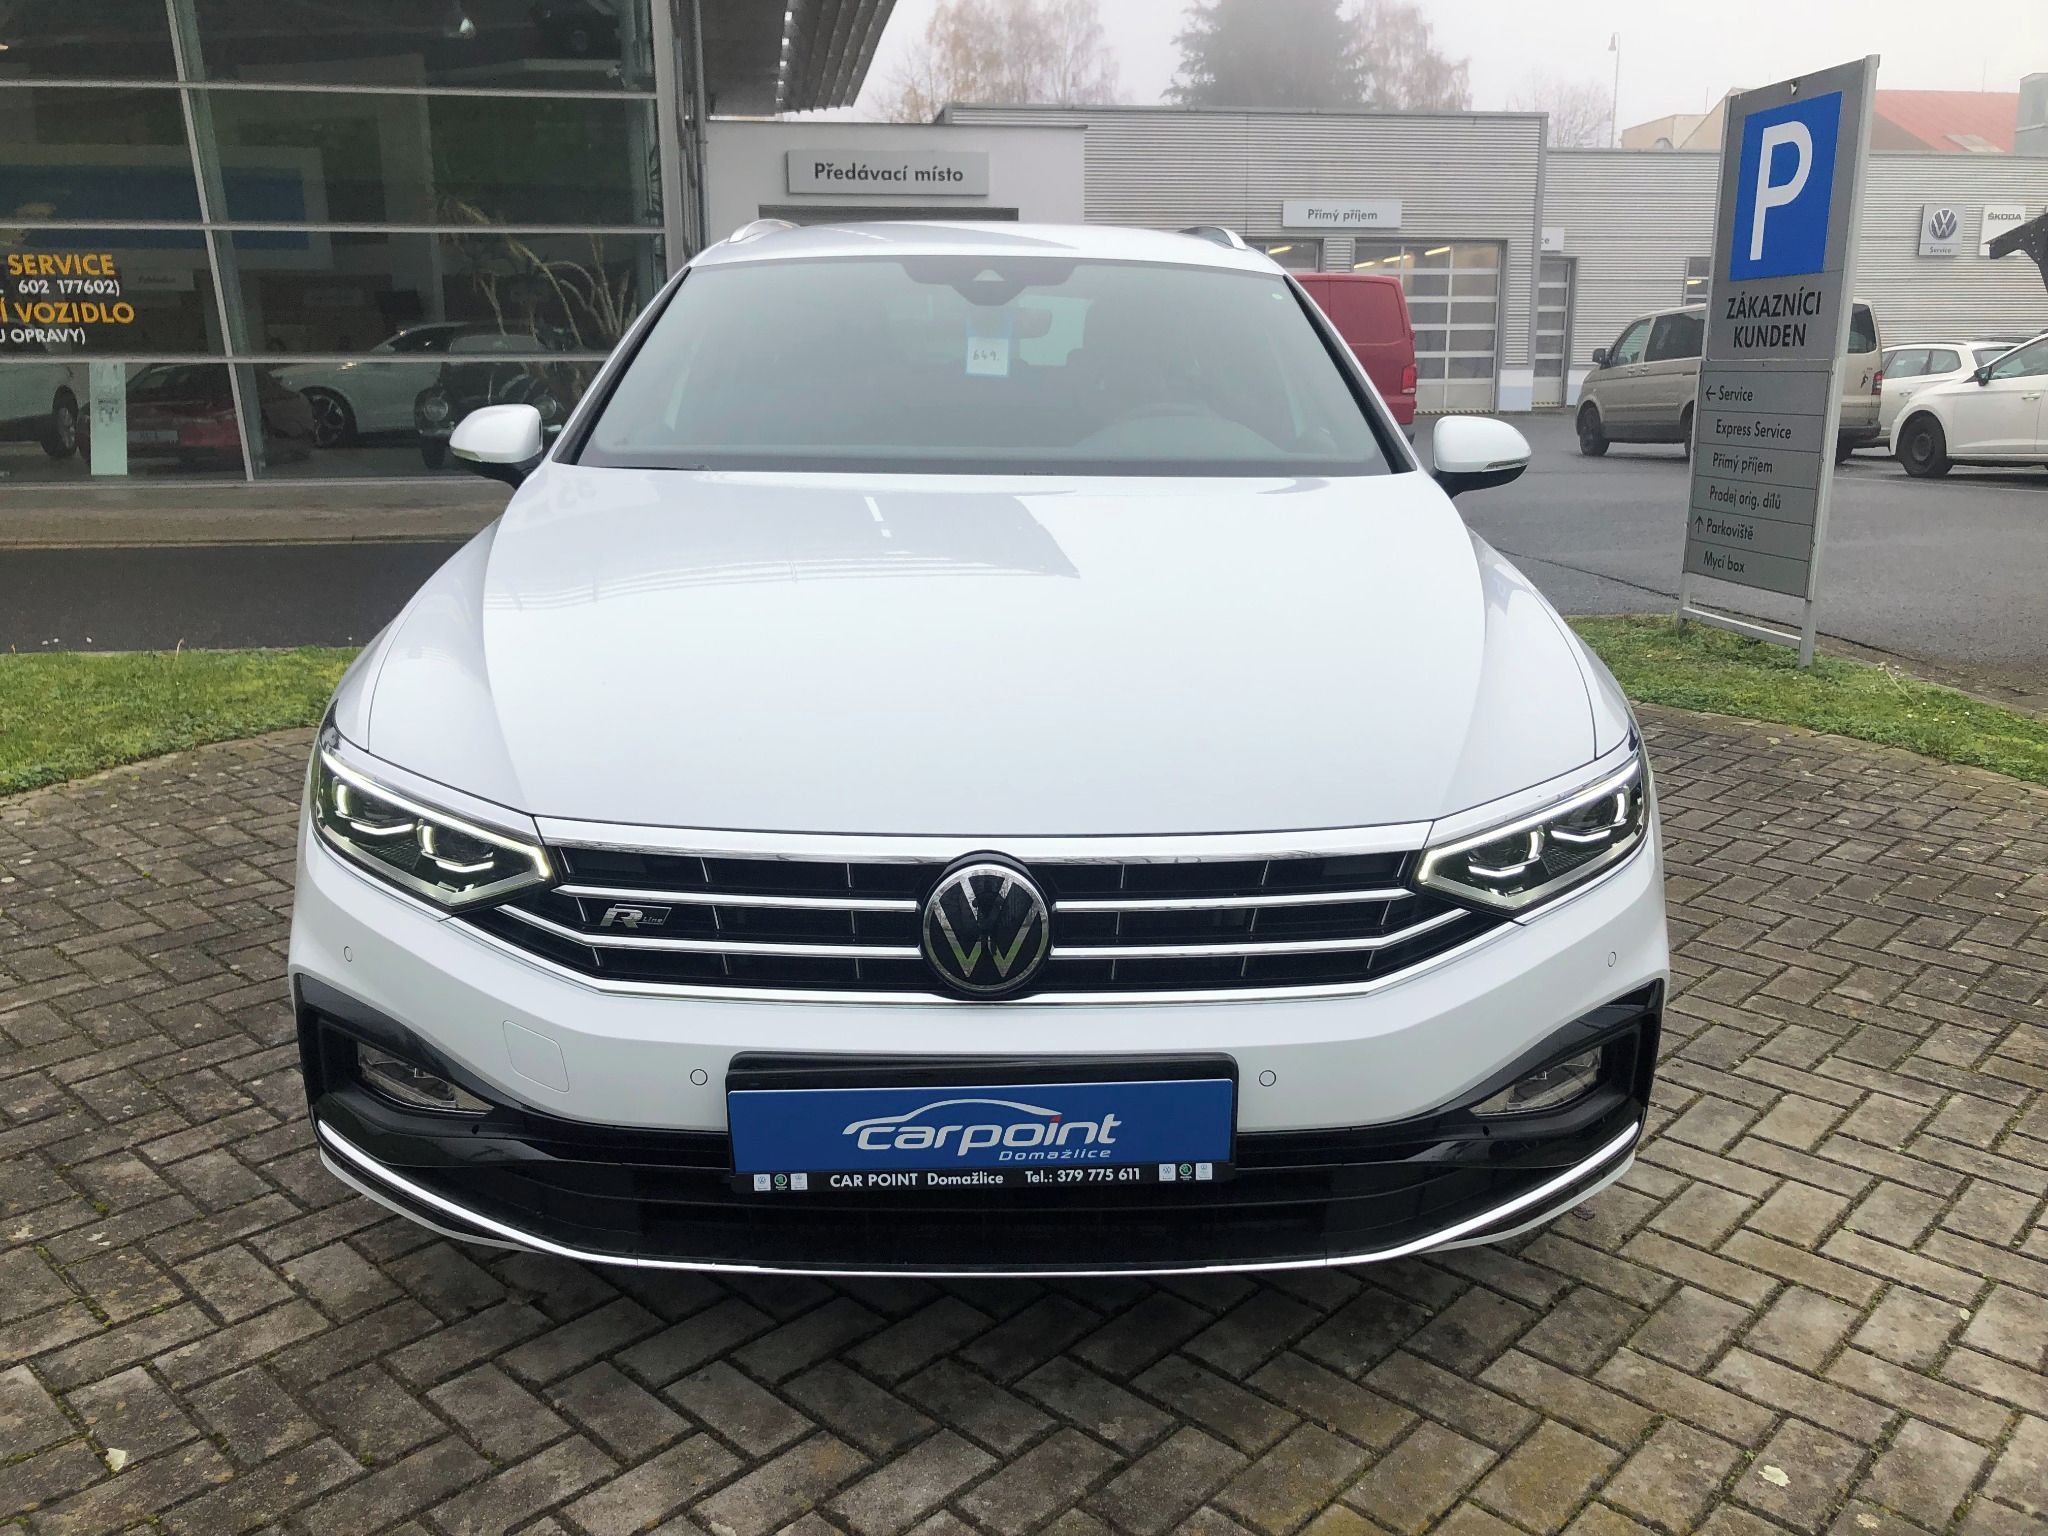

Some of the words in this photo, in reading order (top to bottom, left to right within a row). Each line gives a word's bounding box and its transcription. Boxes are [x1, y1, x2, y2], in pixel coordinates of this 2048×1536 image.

[814, 162, 908, 182] Předávací
[914, 165, 964, 183] místo
[1750, 121, 1812, 261] P
[1307, 208, 1339, 222] Přímý
[1343, 209, 1378, 222] příjem
[8, 254, 116, 275] SERVICE
[18, 280, 50, 294] 602
[57, 279, 120, 297] 177602)
[14, 302, 135, 324] VOZIDLO
[1726, 287, 1822, 320] ZÁKAZNÍCI
[11, 328, 86, 344] OPRAVY)
[1733, 324, 1807, 349] KUNDEN
[1718, 385, 1753, 401] Service
[1715, 419, 1751, 438] Express
[1754, 421, 1792, 439] Service
[1712, 452, 1739, 472] Přímý
[1741, 456, 1773, 475] příjem
[1709, 485, 1738, 507] Prodej
[1739, 491, 1760, 510] orig.
[1762, 492, 1782, 510] dílů
[1706, 518, 1754, 540] Parkoviště
[1703, 551, 1725, 570] Mycí
[1727, 554, 1745, 573] box
[857, 1113, 1122, 1157] carpoint
[998, 1148, 1112, 1161] Domažlice
[829, 1174, 863, 1188] CAR
[868, 1172, 918, 1187] POINT
[927, 1170, 1004, 1186] Domažlice
[1025, 1170, 1053, 1183] Tel.:
[1057, 1169, 1084, 1182] 379
[1087, 1168, 1114, 1181] 775
[1118, 1167, 1141, 1180] 611
